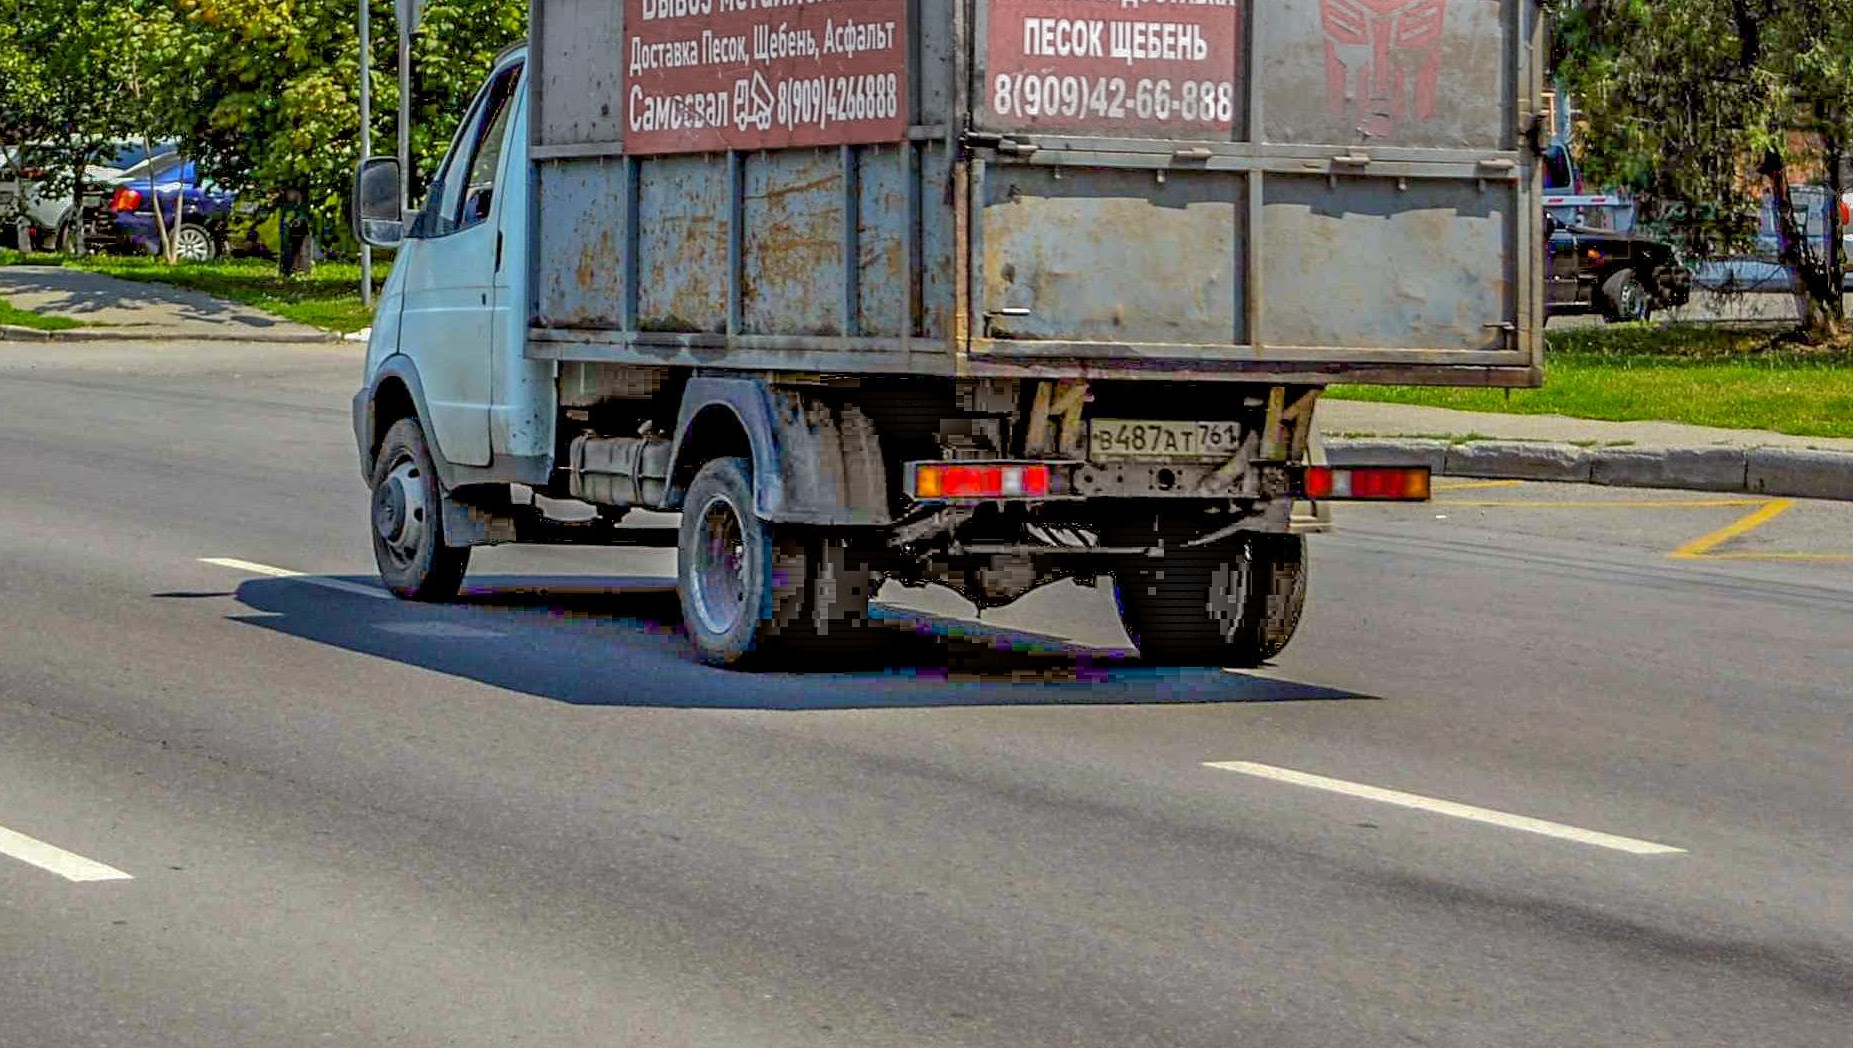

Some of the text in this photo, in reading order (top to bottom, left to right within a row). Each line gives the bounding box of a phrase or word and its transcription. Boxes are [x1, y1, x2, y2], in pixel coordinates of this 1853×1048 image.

[629, 18, 895, 77] Доставка Песок, Щебень, Асфальт
[1023, 17, 1208, 66] ПЕСОК ЩЕБЕНЬ
[629, 72, 897, 132] Самосвал 8(909)4266888
[994, 72, 1235, 123] 8(909)42-66-888
